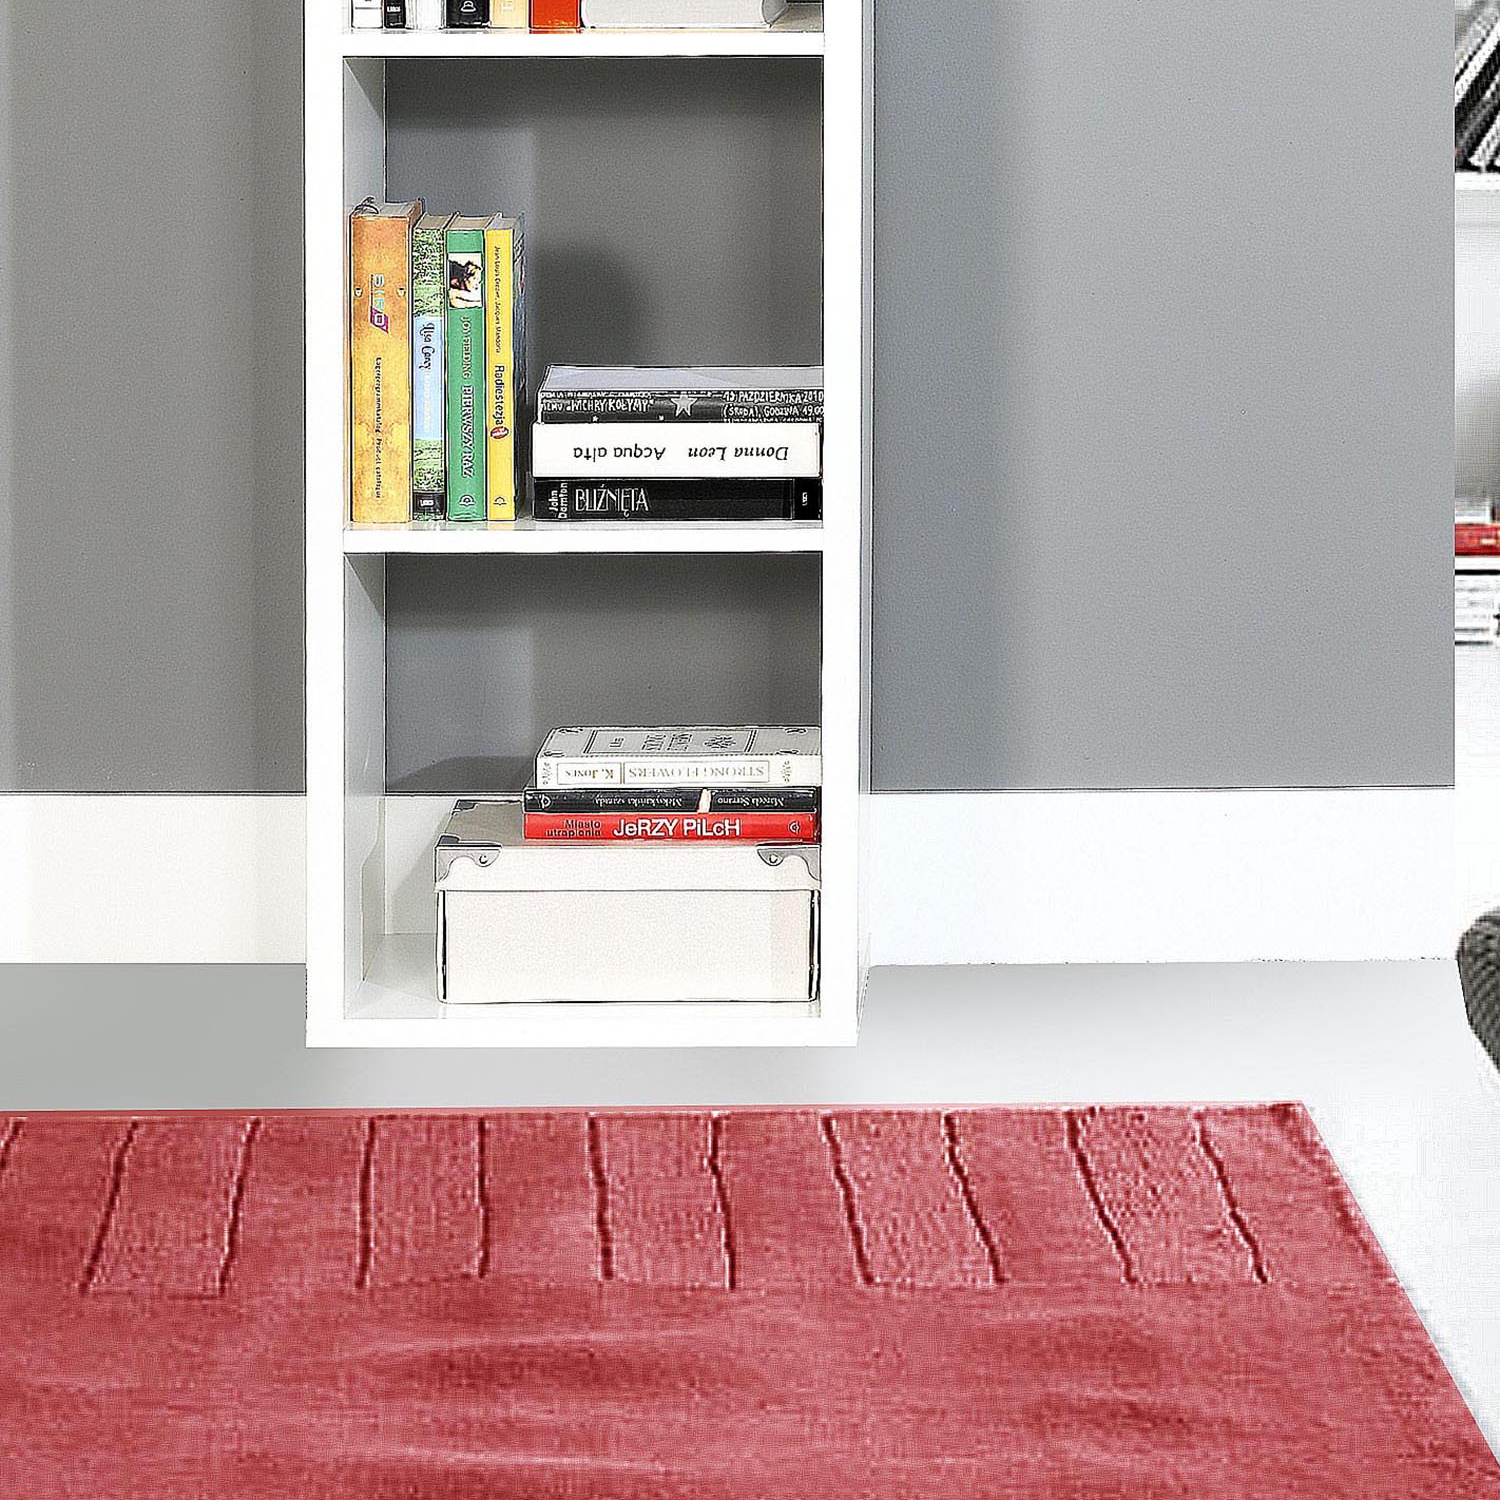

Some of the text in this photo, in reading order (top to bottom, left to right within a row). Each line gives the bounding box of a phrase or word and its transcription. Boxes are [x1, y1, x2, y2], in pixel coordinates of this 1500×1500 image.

[461, 317, 472, 379] JOY FIELDING
[492, 365, 506, 426] Radiestezja
[461, 385, 474, 478] PIERWSZY RAZ
[572, 443, 789, 463] Donna Leon Acqua alta
[548, 490, 559, 511] John
[602, 768, 614, 779] K.
[628, 766, 765, 778] STRONG FLOWERS
[717, 797, 750, 807] Serrano
[545, 828, 602, 838] utrapienia
[564, 819, 601, 829] Miasto
[613, 818, 741, 836] JeRZY PiLcH
